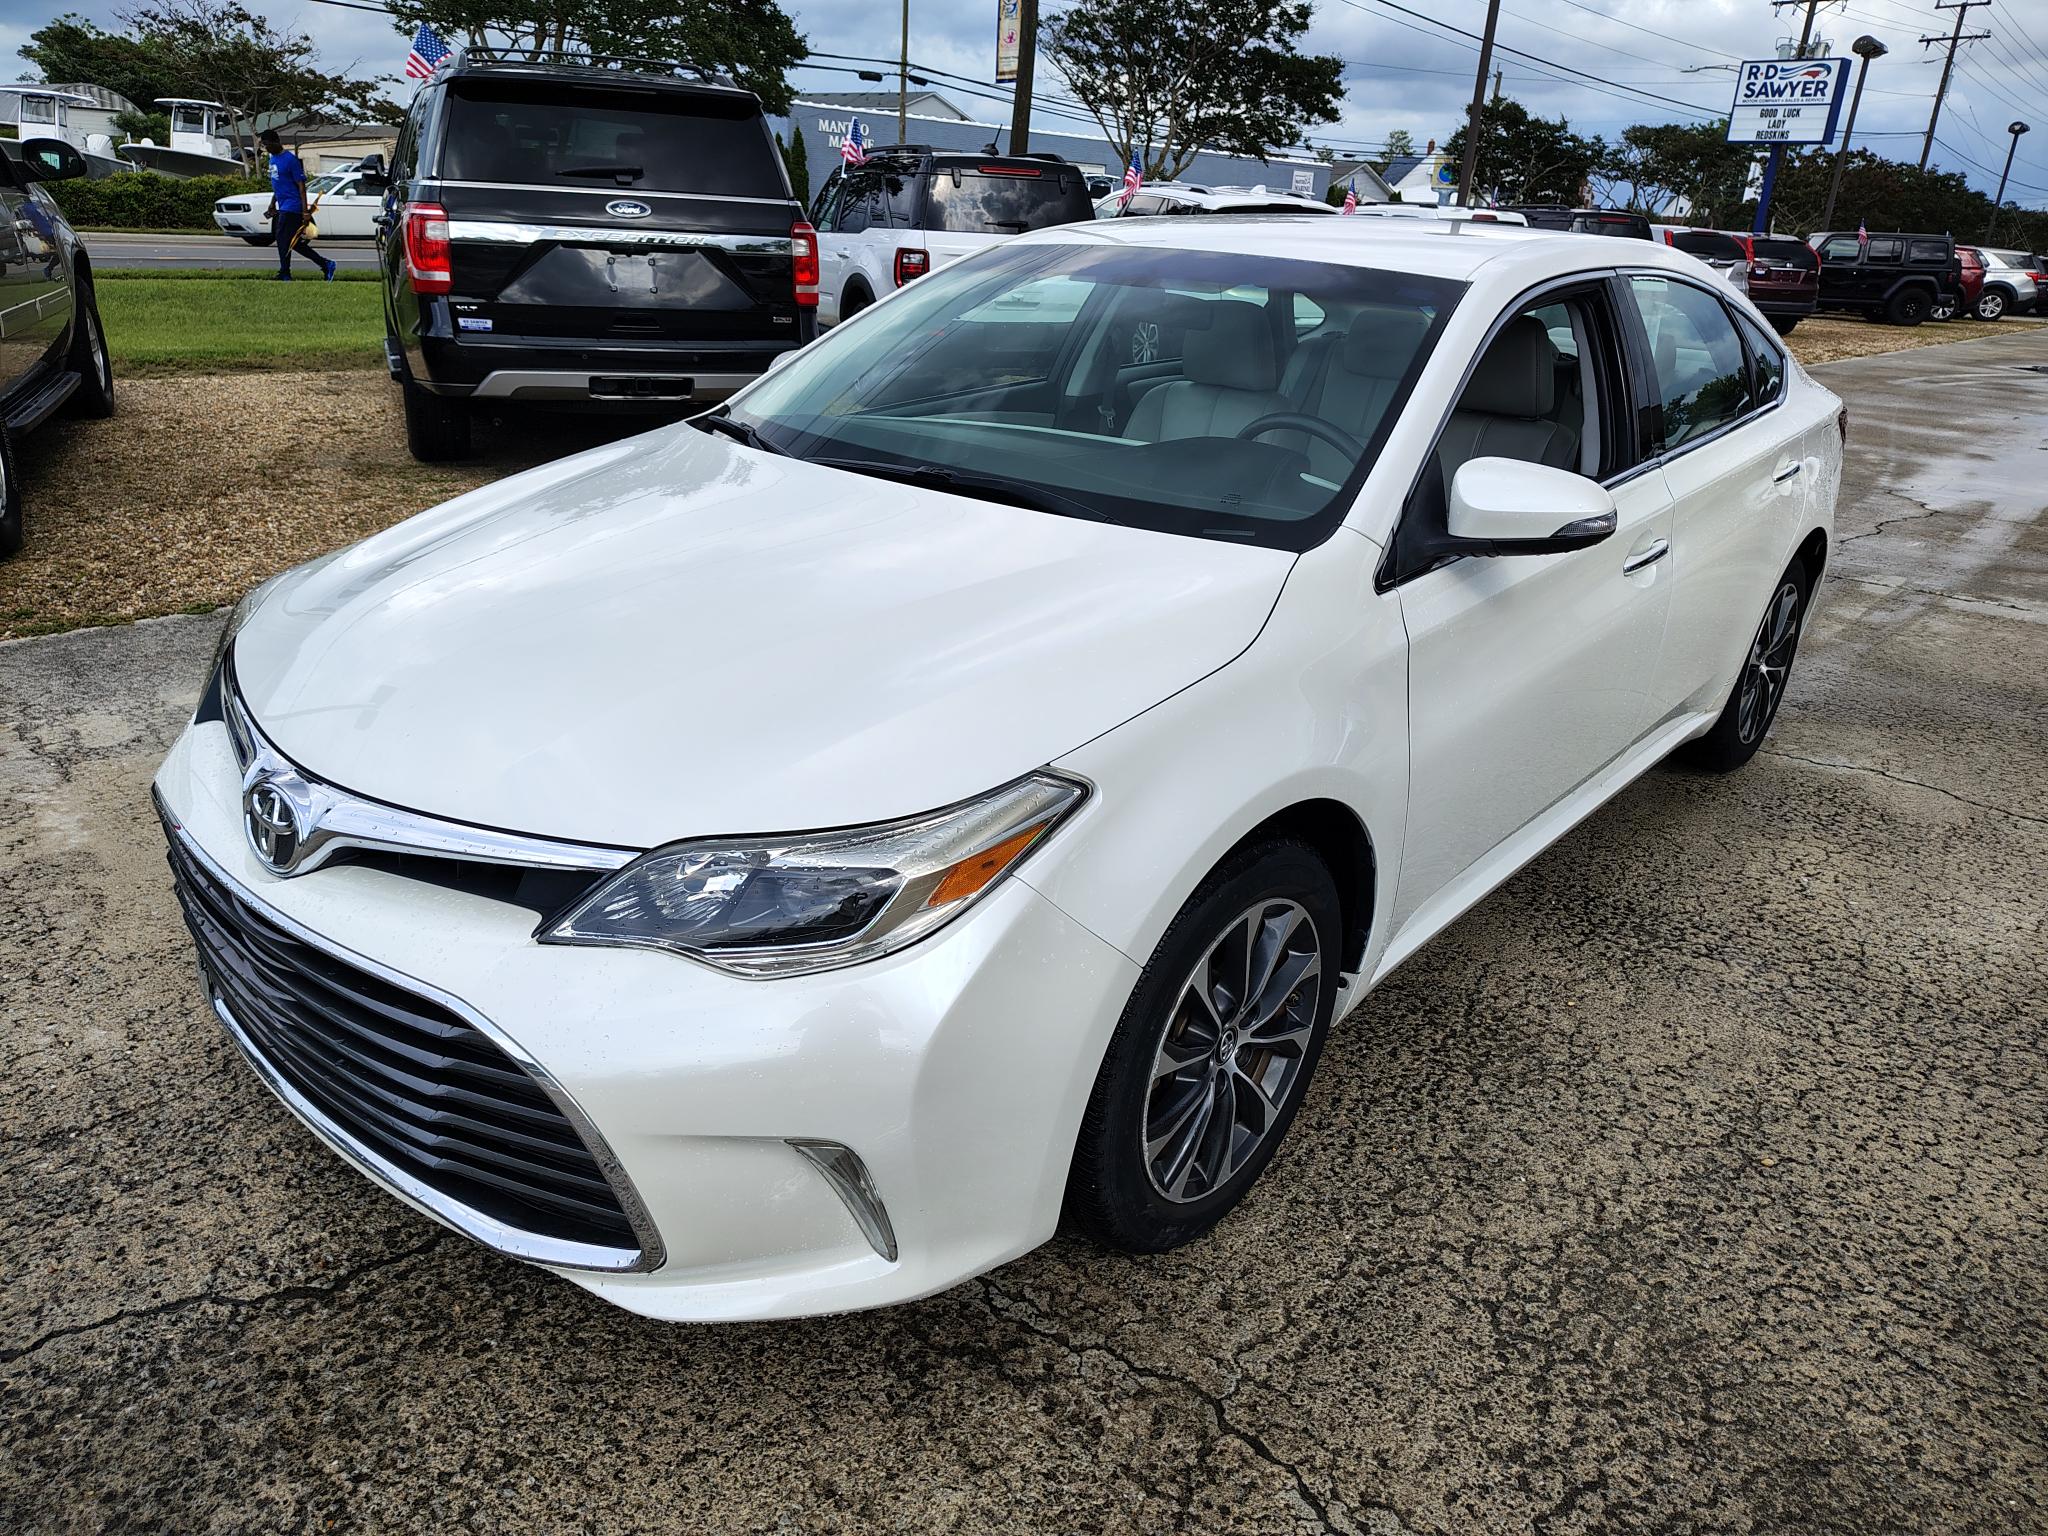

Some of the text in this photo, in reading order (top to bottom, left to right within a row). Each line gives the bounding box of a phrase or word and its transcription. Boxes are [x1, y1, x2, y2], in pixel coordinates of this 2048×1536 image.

[1744, 81, 1828, 98] SAWYER
[1760, 108, 1801, 118] GOOD LUCK
[818, 119, 869, 136] MANTO
[1767, 119, 1787, 129] LADY
[1756, 130, 1790, 140] REDSKINS
[613, 202, 641, 214] Ford
[554, 230, 706, 245] EXPEDITION
